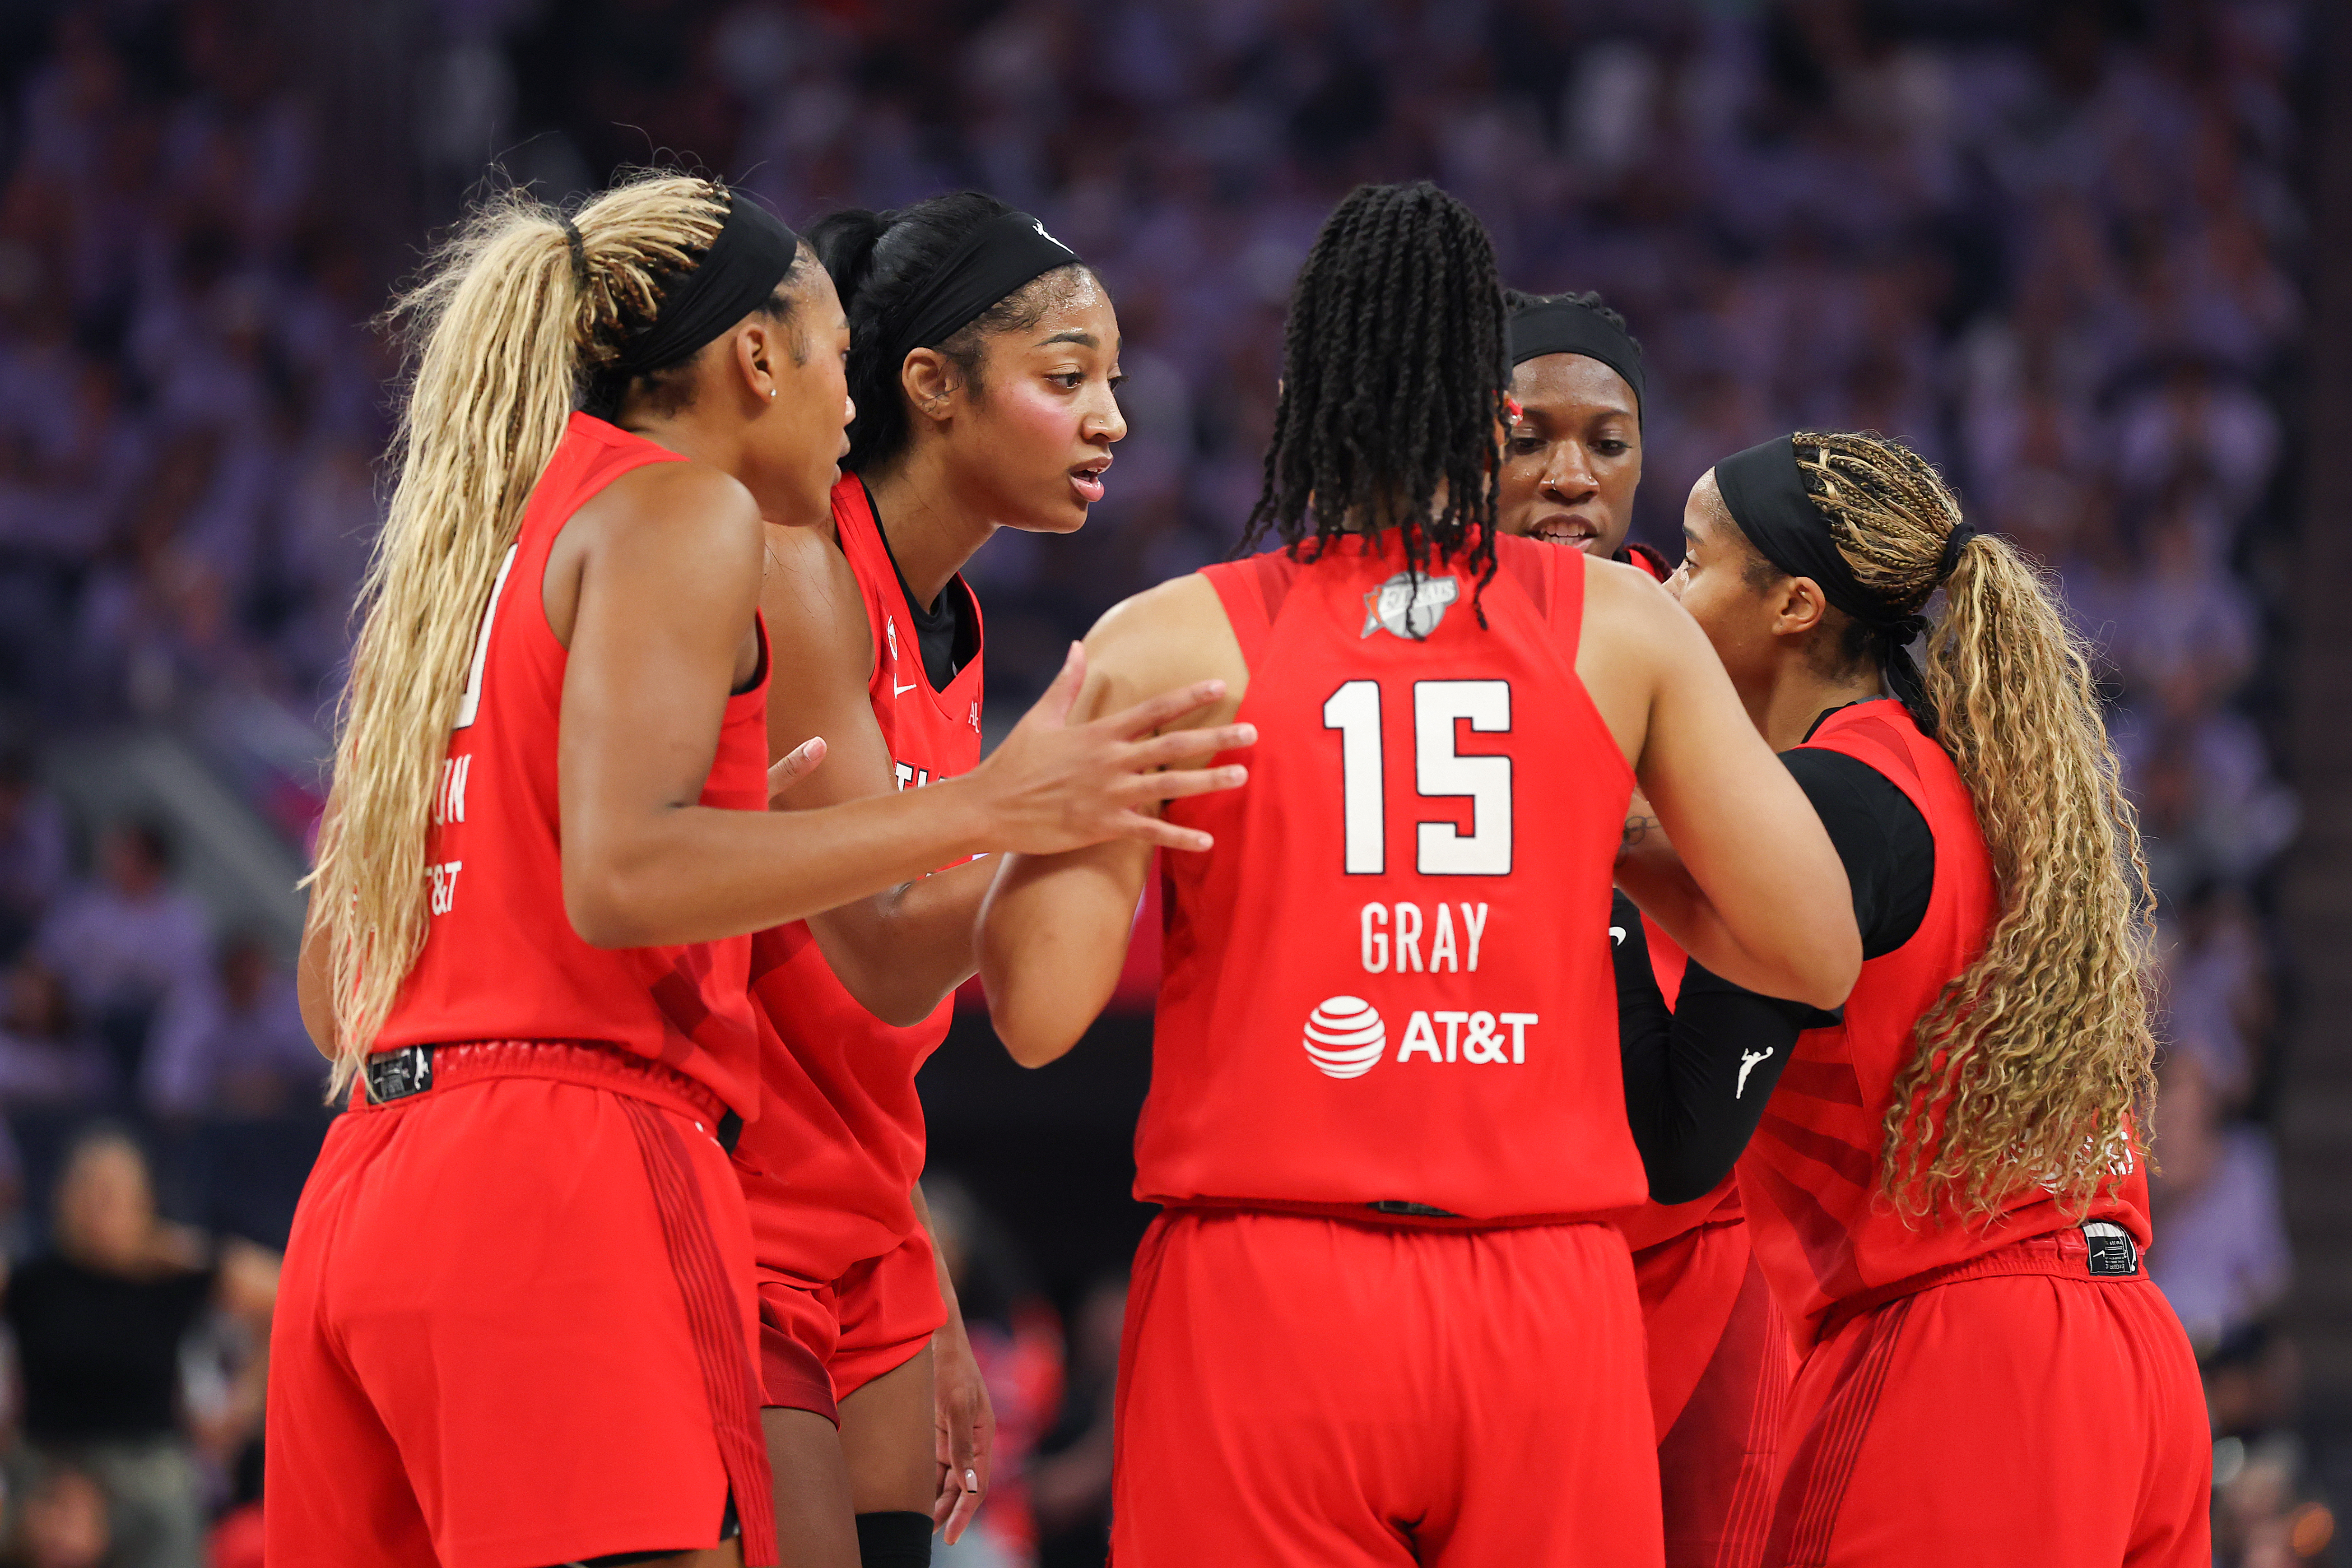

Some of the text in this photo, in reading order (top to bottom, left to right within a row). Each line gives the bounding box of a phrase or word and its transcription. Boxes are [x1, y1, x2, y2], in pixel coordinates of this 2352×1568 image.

[1323, 680, 1512, 875] 15
[425, 860, 463, 916] &T
[1361, 902, 1488, 973] GRAY
[1397, 1011, 1539, 1064] AT&T
